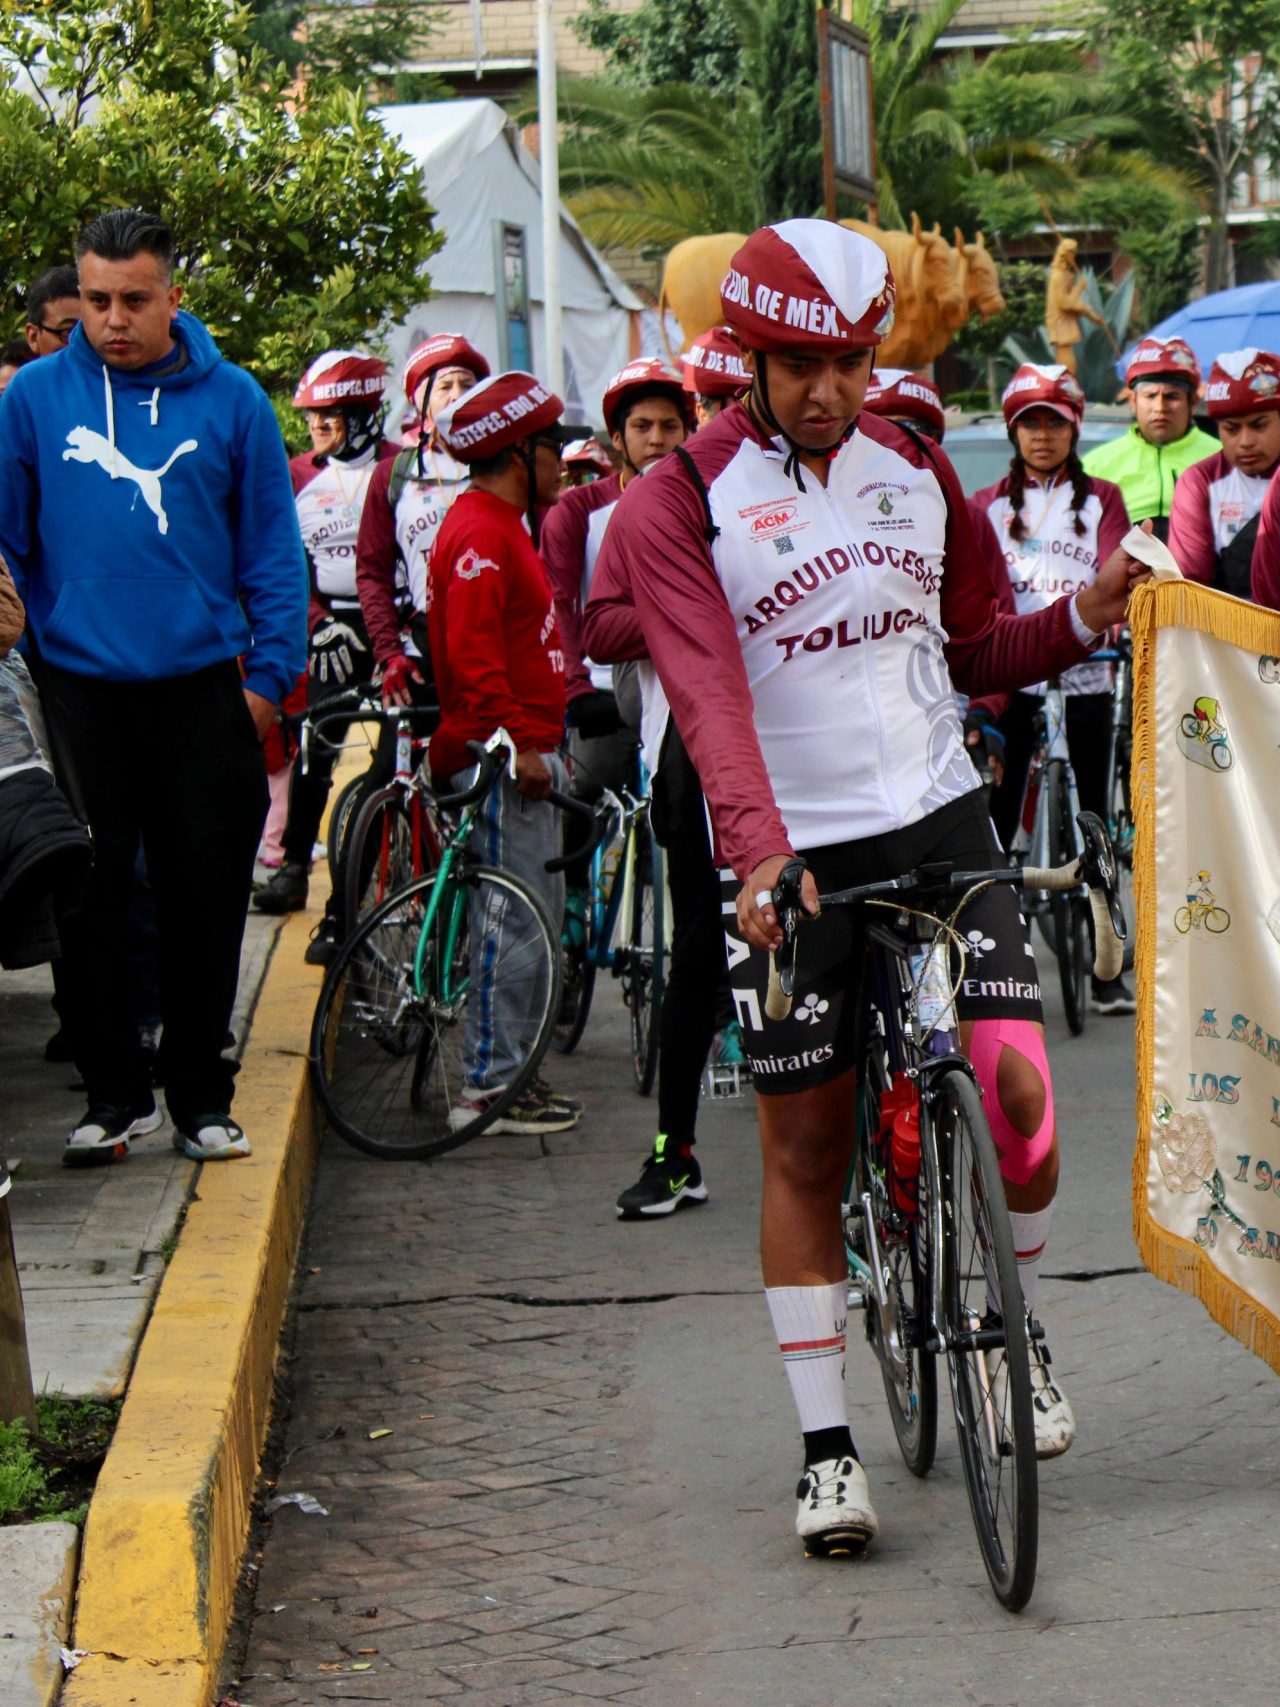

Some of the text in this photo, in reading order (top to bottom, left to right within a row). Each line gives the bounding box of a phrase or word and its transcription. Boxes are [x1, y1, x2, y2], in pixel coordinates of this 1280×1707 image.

[725, 268, 848, 338] EDO. DE MÉX.
[704, 350, 724, 372] DE
[313, 376, 364, 400] METEPEC,
[450, 410, 512, 450] METEPEC,
[503, 393, 538, 422] EDO.
[754, 512, 790, 531] ACM
[776, 607, 929, 663] TOLUCA
[1195, 1008, 1222, 1039] A
[1186, 1071, 1242, 1105] LOS
[1194, 1215, 1219, 1248] 50
